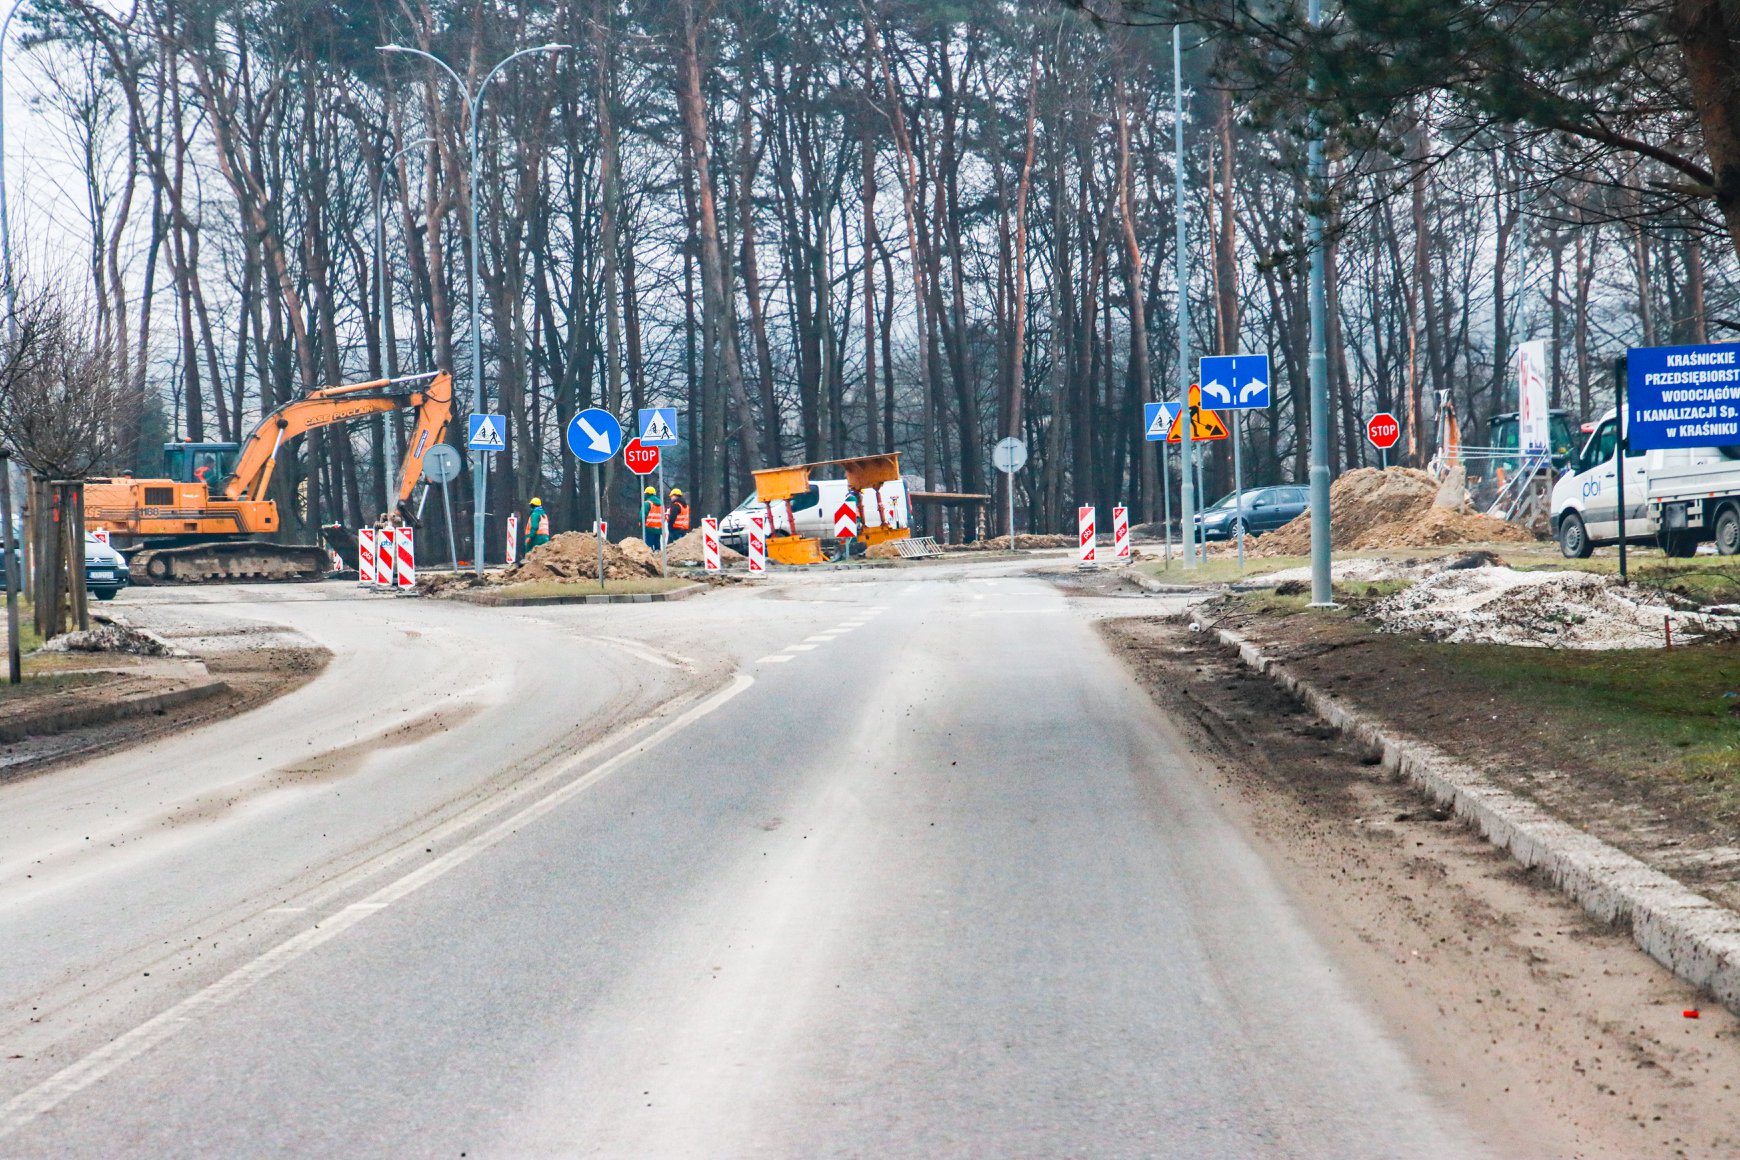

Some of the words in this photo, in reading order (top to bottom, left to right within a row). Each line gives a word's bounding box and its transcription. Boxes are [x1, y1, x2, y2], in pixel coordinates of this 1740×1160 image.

[1666, 351, 1735, 367] KRAŚNICKIE
[1661, 385, 1740, 403] WODOCIĄGÓW
[304, 414, 331, 426] CASE
[333, 405, 374, 420] POCLAIN
[1636, 410, 1641, 422] I
[1643, 406, 1717, 422] KANALIZACJI
[1719, 405, 1739, 419] Sp.
[1370, 424, 1396, 437] STOP
[1666, 427, 1677, 438] w
[1679, 421, 1738, 437] KRAŚNIKU
[628, 450, 656, 462] STOP
[1582, 475, 1602, 504] pbi
